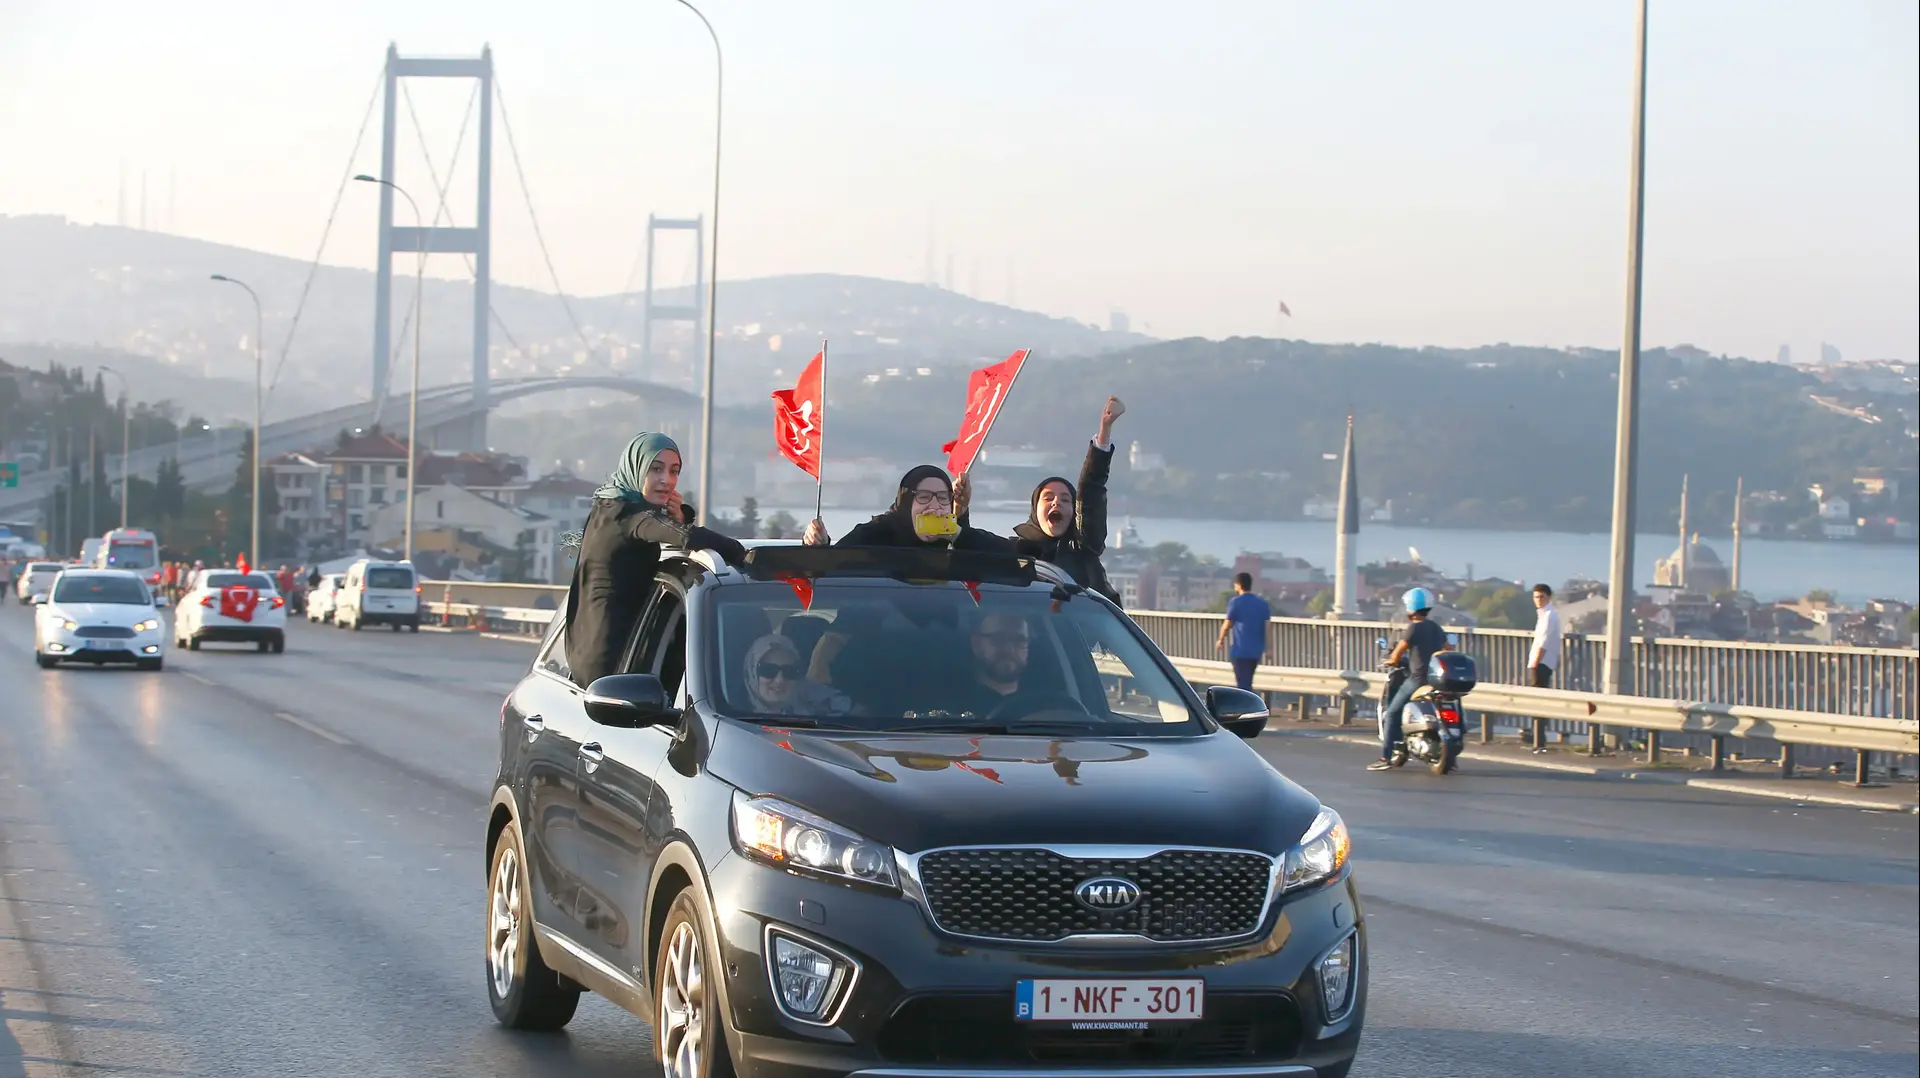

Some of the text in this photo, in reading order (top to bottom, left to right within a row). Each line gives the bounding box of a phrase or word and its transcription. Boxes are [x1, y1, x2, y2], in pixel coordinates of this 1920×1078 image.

[1088, 885, 1130, 904] KIA
[1040, 986, 1196, 1014] 1-NKF-301
[1018, 1002, 1029, 1015] B
[1071, 1021, 1149, 1030] WWW.KIAVERMANT.BE
